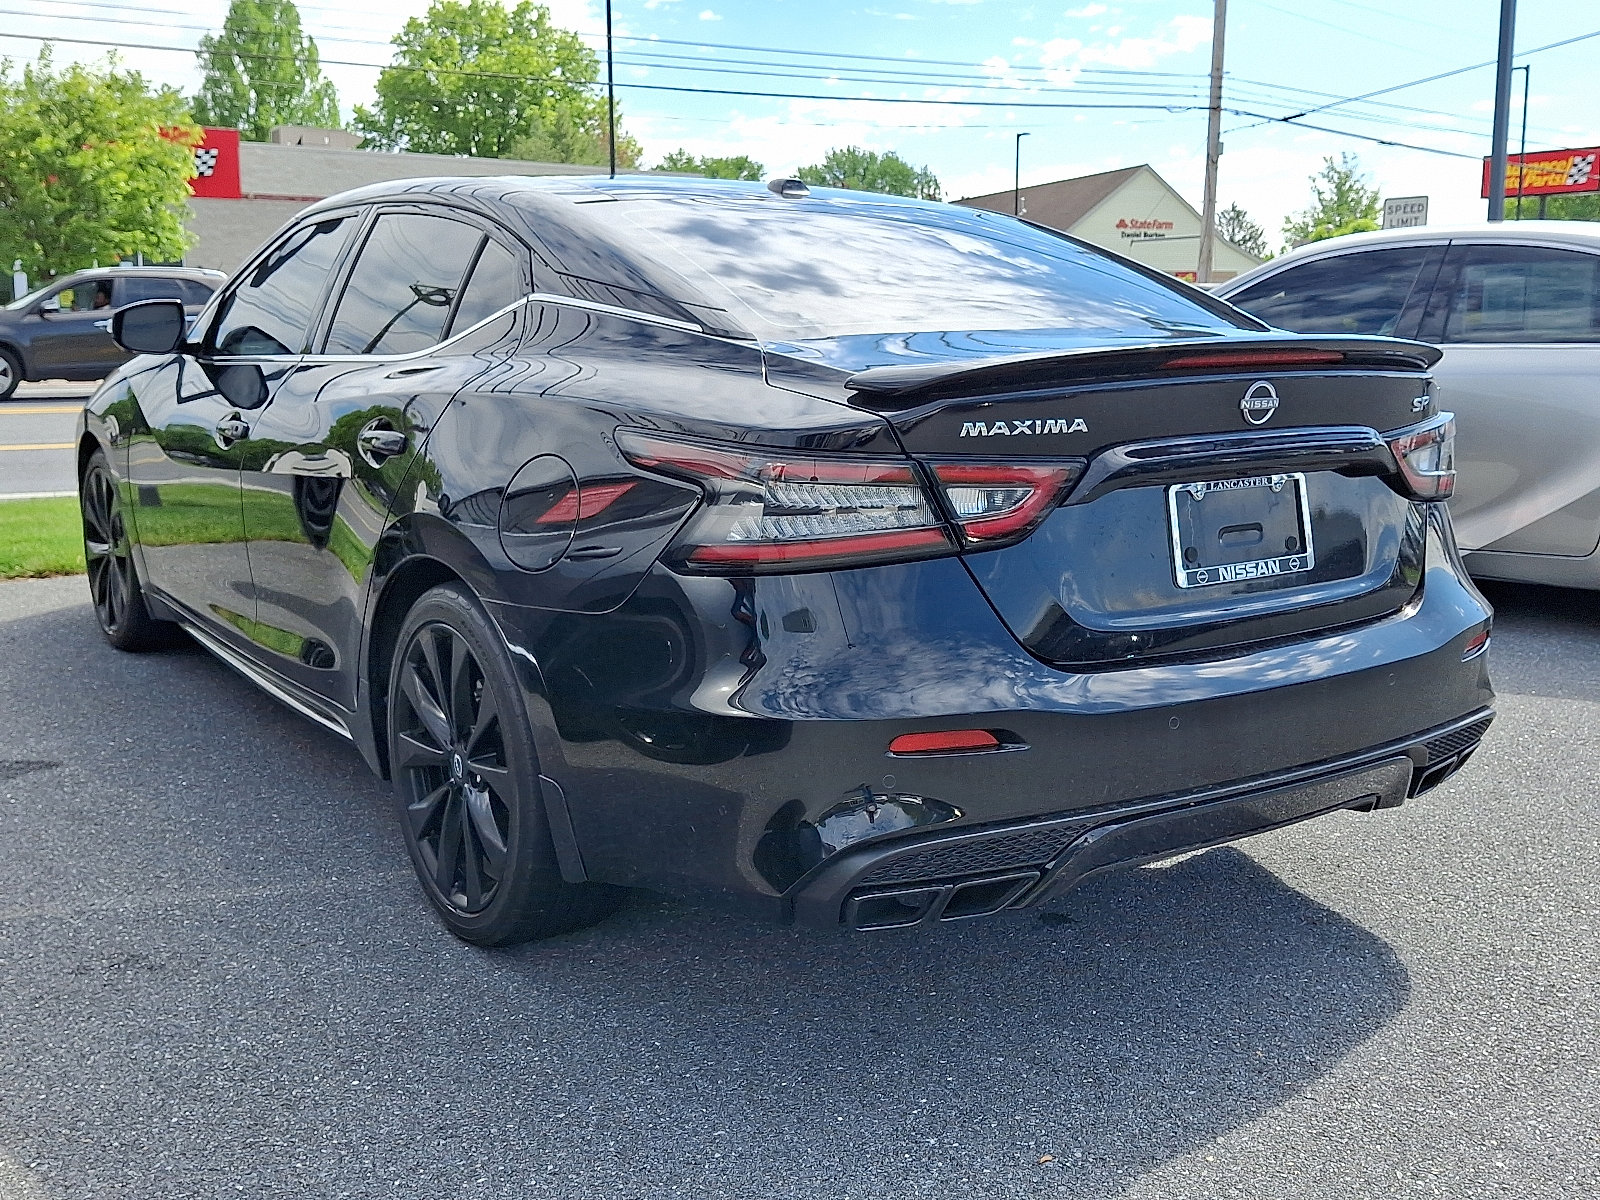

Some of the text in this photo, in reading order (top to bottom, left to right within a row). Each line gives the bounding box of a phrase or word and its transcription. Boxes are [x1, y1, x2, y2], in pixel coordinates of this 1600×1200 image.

[1387, 203, 1425, 215] SPEED
[1390, 216, 1419, 228] LIMIT
[1241, 399, 1279, 409] NISSAN
[959, 418, 1089, 438] MAXIMA
[1210, 477, 1270, 491] LANCASTER
[1219, 559, 1281, 582] NISSAN
